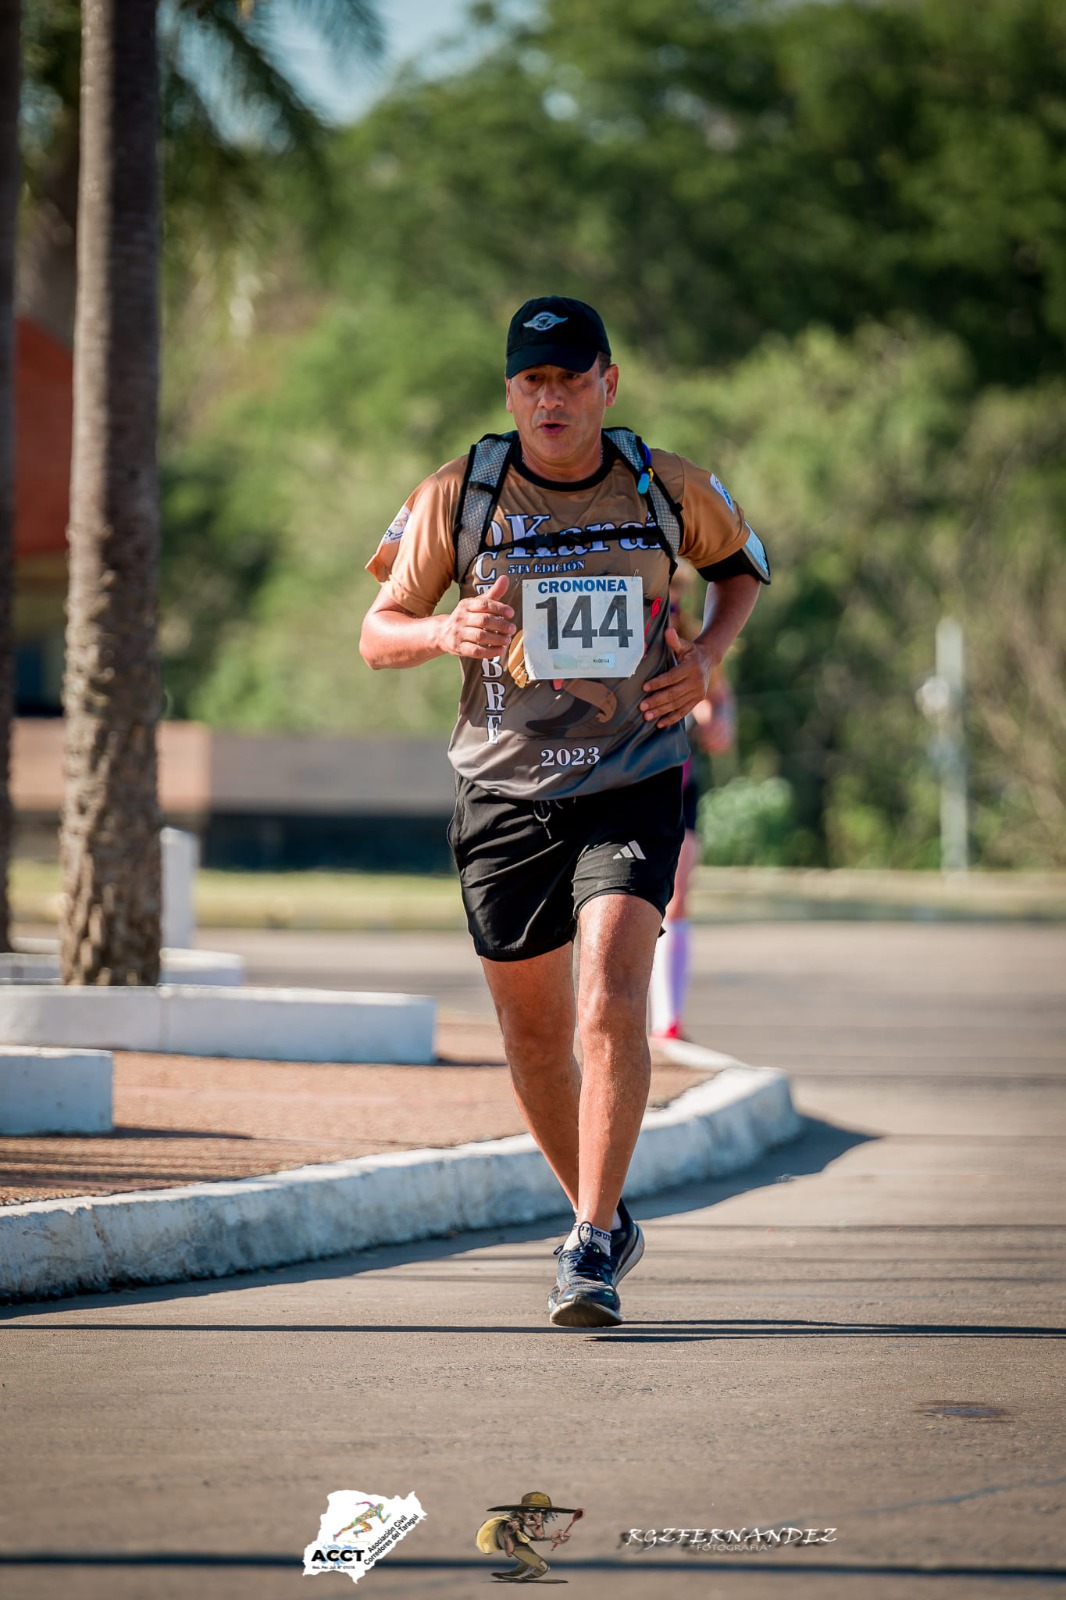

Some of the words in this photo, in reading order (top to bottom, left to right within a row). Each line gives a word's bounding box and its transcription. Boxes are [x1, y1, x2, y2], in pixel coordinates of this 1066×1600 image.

[508, 563, 530, 574] 5TA
[534, 560, 585, 573] EDICIÓN
[537, 579, 628, 594] CRONONEA
[535, 595, 633, 650] 144
[540, 747, 600, 767] 2023
